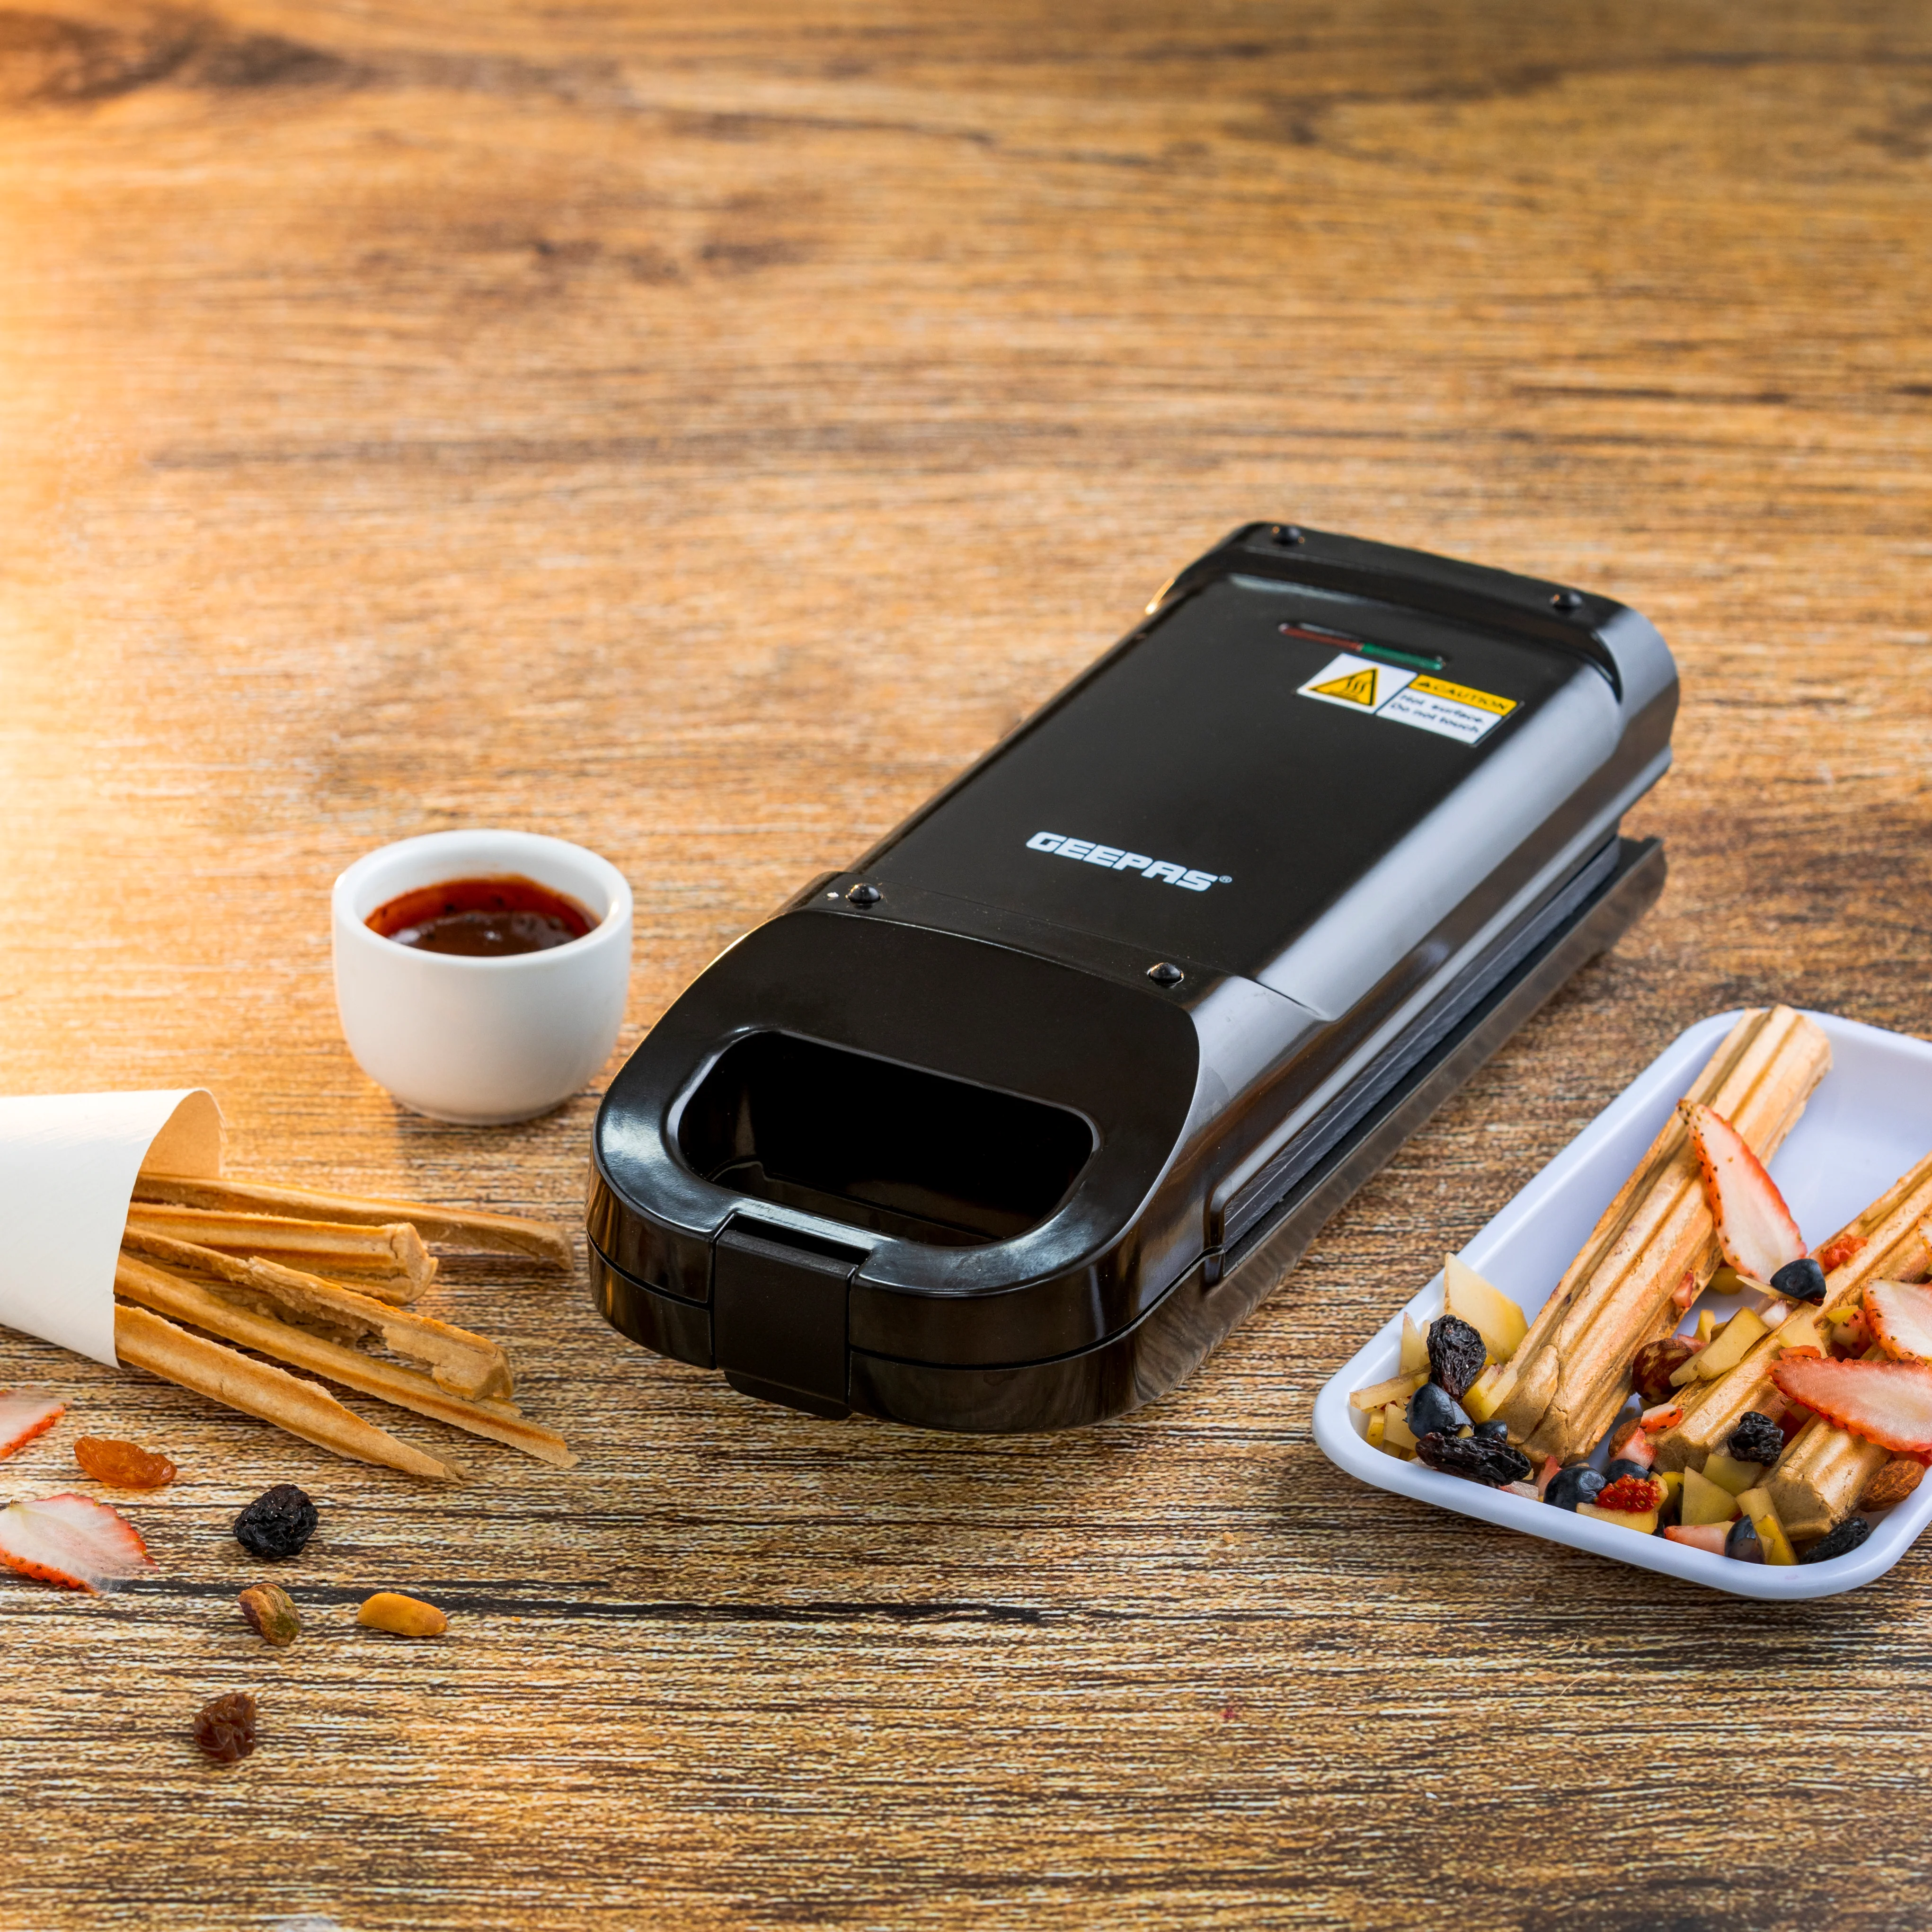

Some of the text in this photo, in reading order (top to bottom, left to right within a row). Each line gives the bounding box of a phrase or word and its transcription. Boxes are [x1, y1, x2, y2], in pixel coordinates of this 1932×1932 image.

[1401, 694, 1425, 705] Hot
[1434, 683, 1507, 710] CAUTION
[1391, 702, 1410, 712] Do
[1413, 709, 1436, 720] not
